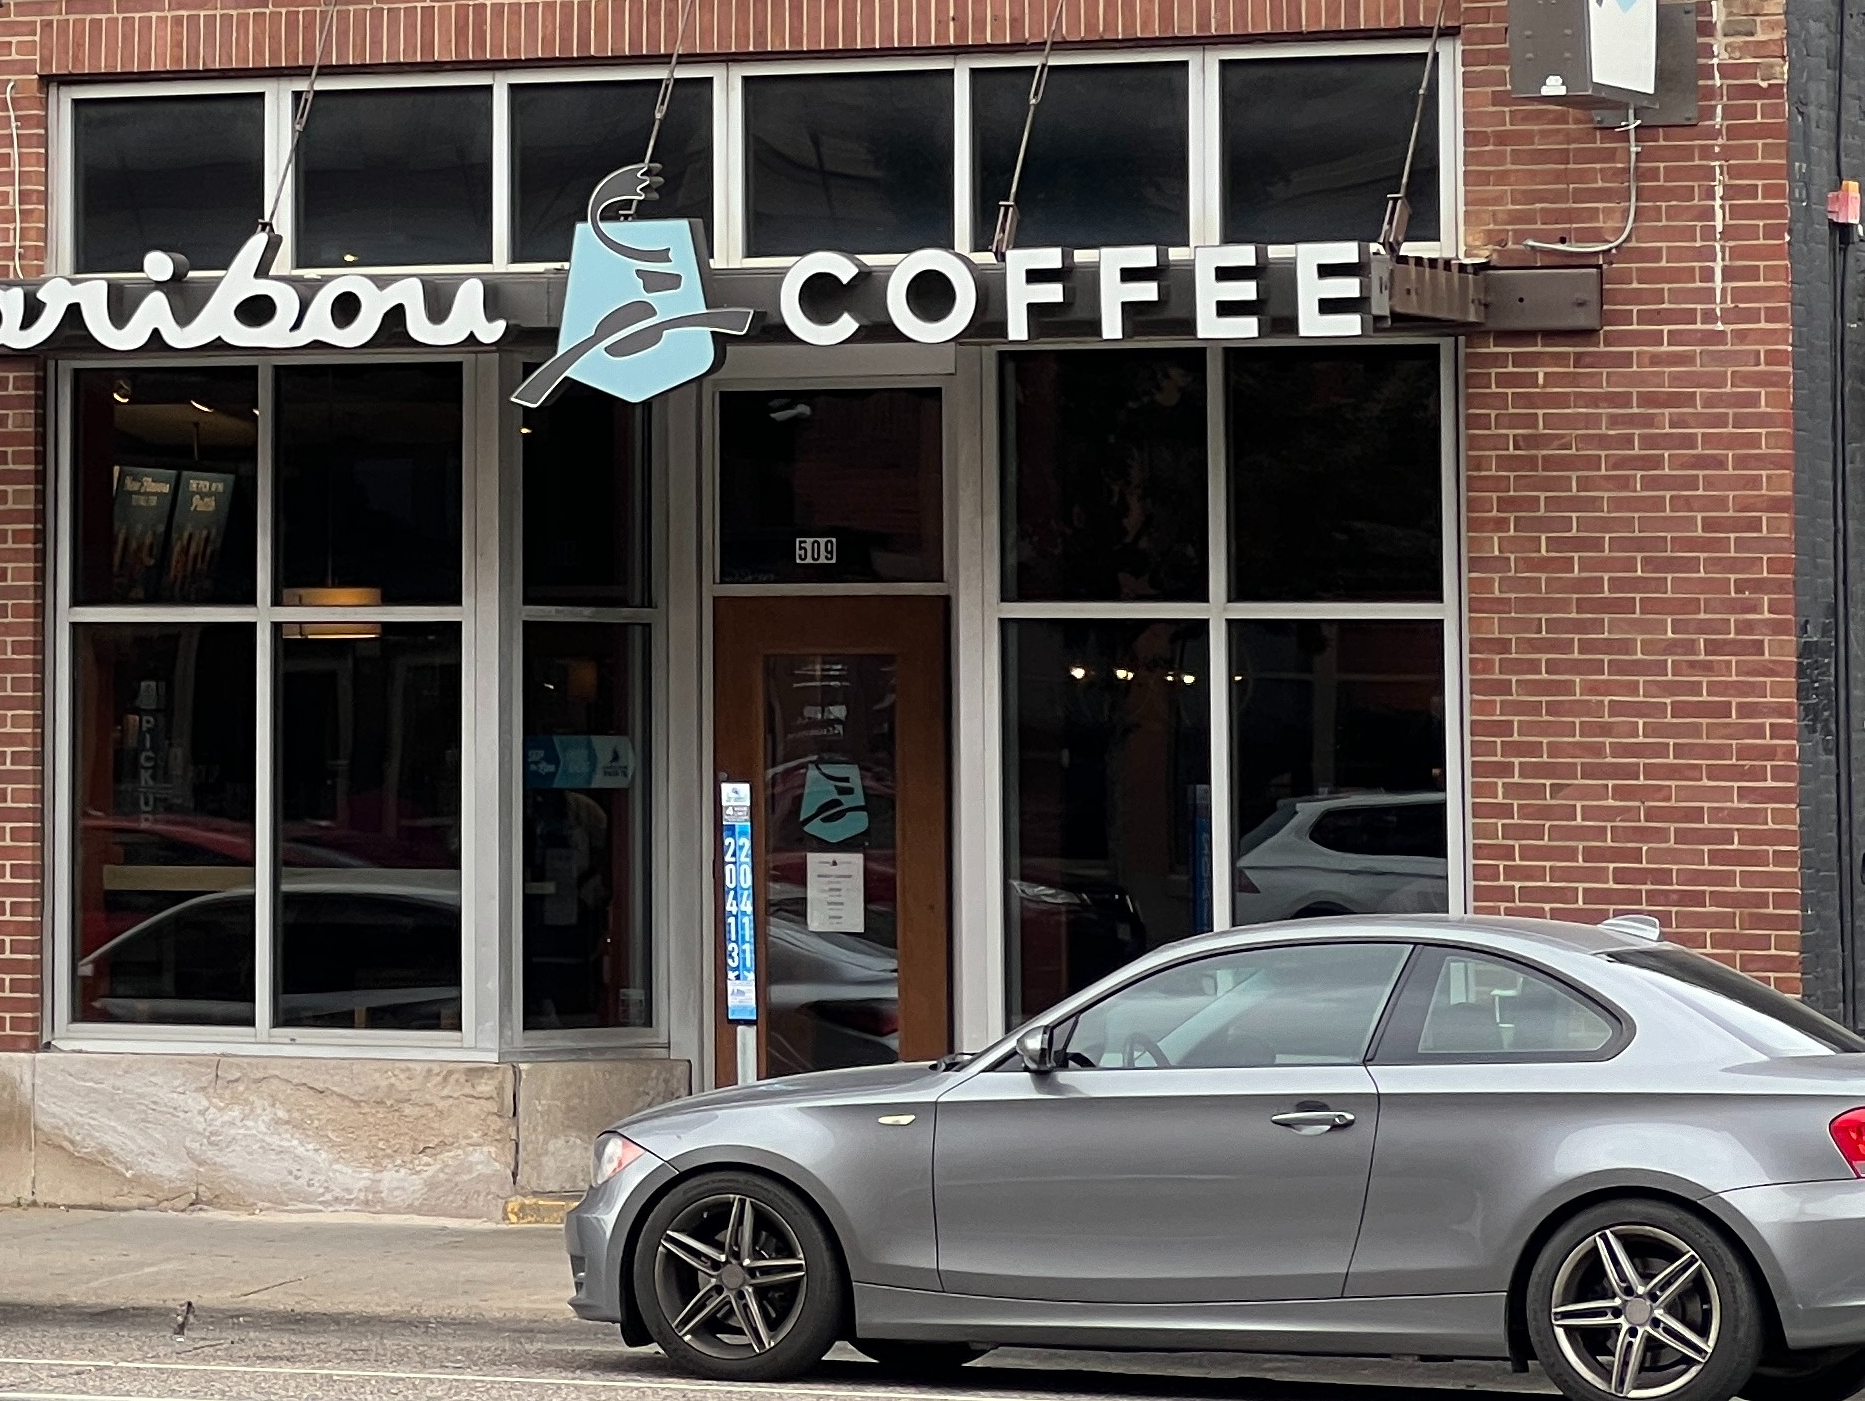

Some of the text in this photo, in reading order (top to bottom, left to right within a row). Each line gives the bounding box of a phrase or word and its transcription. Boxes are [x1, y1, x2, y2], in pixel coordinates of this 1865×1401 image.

[779, 241, 1368, 345] COFFEE
[798, 539, 834, 562] 509
[724, 837, 739, 968] 20413
[739, 837, 753, 968] 20411
